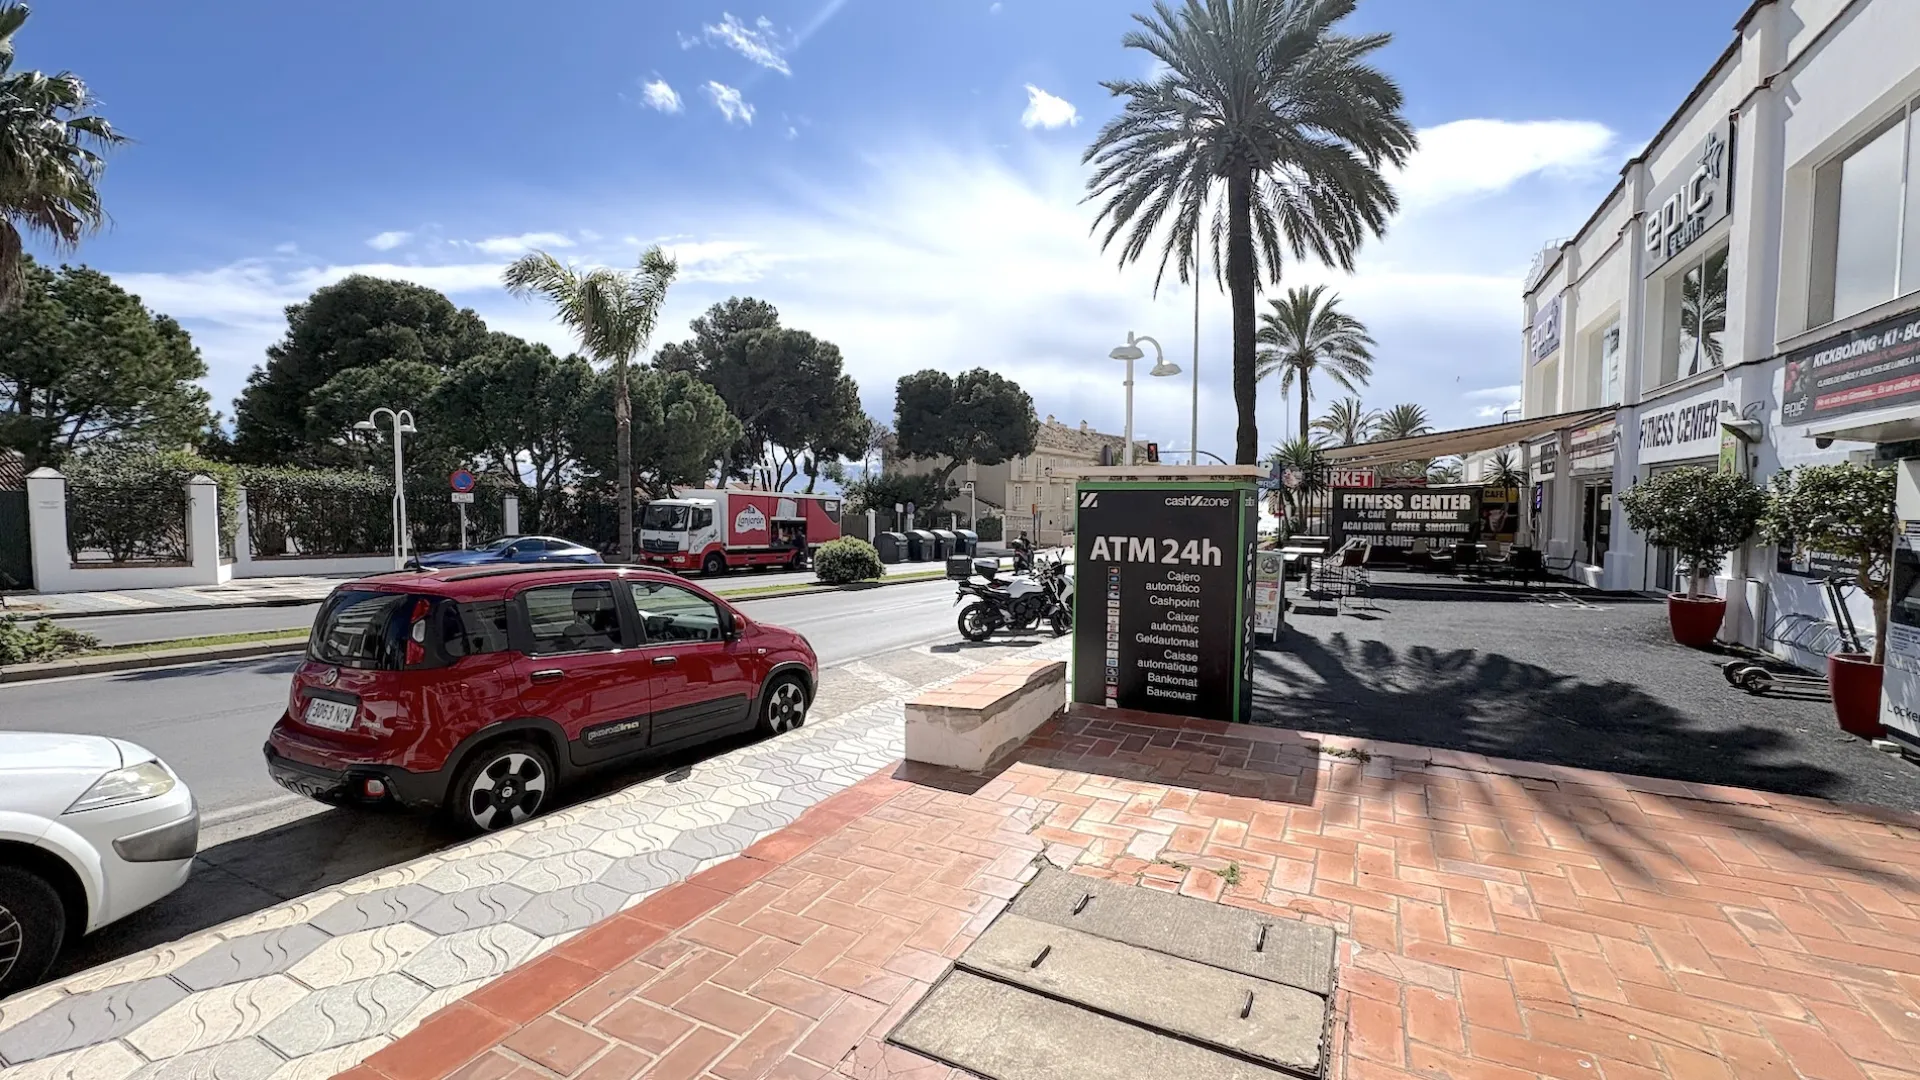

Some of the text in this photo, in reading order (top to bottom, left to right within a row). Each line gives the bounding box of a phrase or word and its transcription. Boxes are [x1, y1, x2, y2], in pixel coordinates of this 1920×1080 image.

[1645, 164, 1708, 257] epic
[1813, 335, 1877, 368] KICKBOXING
[1639, 411, 1675, 449] FITNESS
[1677, 400, 1719, 444] CENTER
[1343, 494, 1471, 510] FITNESS CENTER
[1396, 511, 1430, 520] PROTEIN
[1431, 511, 1458, 520] SHAKE
[1363, 521, 1386, 531] BOWL
[1391, 522, 1420, 531] COFFEE
[1425, 523, 1470, 533] SMOOTHIE
[1090, 536, 1222, 566] ATM 24h
[1167, 571, 1200, 583] Cajero
[1146, 581, 1200, 594] automático
[1150, 596, 1200, 608] Cashpoint
[1167, 611, 1199, 622] Caixer
[1151, 621, 1199, 634] automàtic
[1136, 633, 1199, 648] Geldautomat
[1164, 650, 1198, 662] Caisse
[1137, 659, 1198, 673] automatique
[1148, 673, 1198, 687] Bankomat
[1146, 686, 1198, 701] Банкомат
[1887, 701, 1920, 722] Locke
